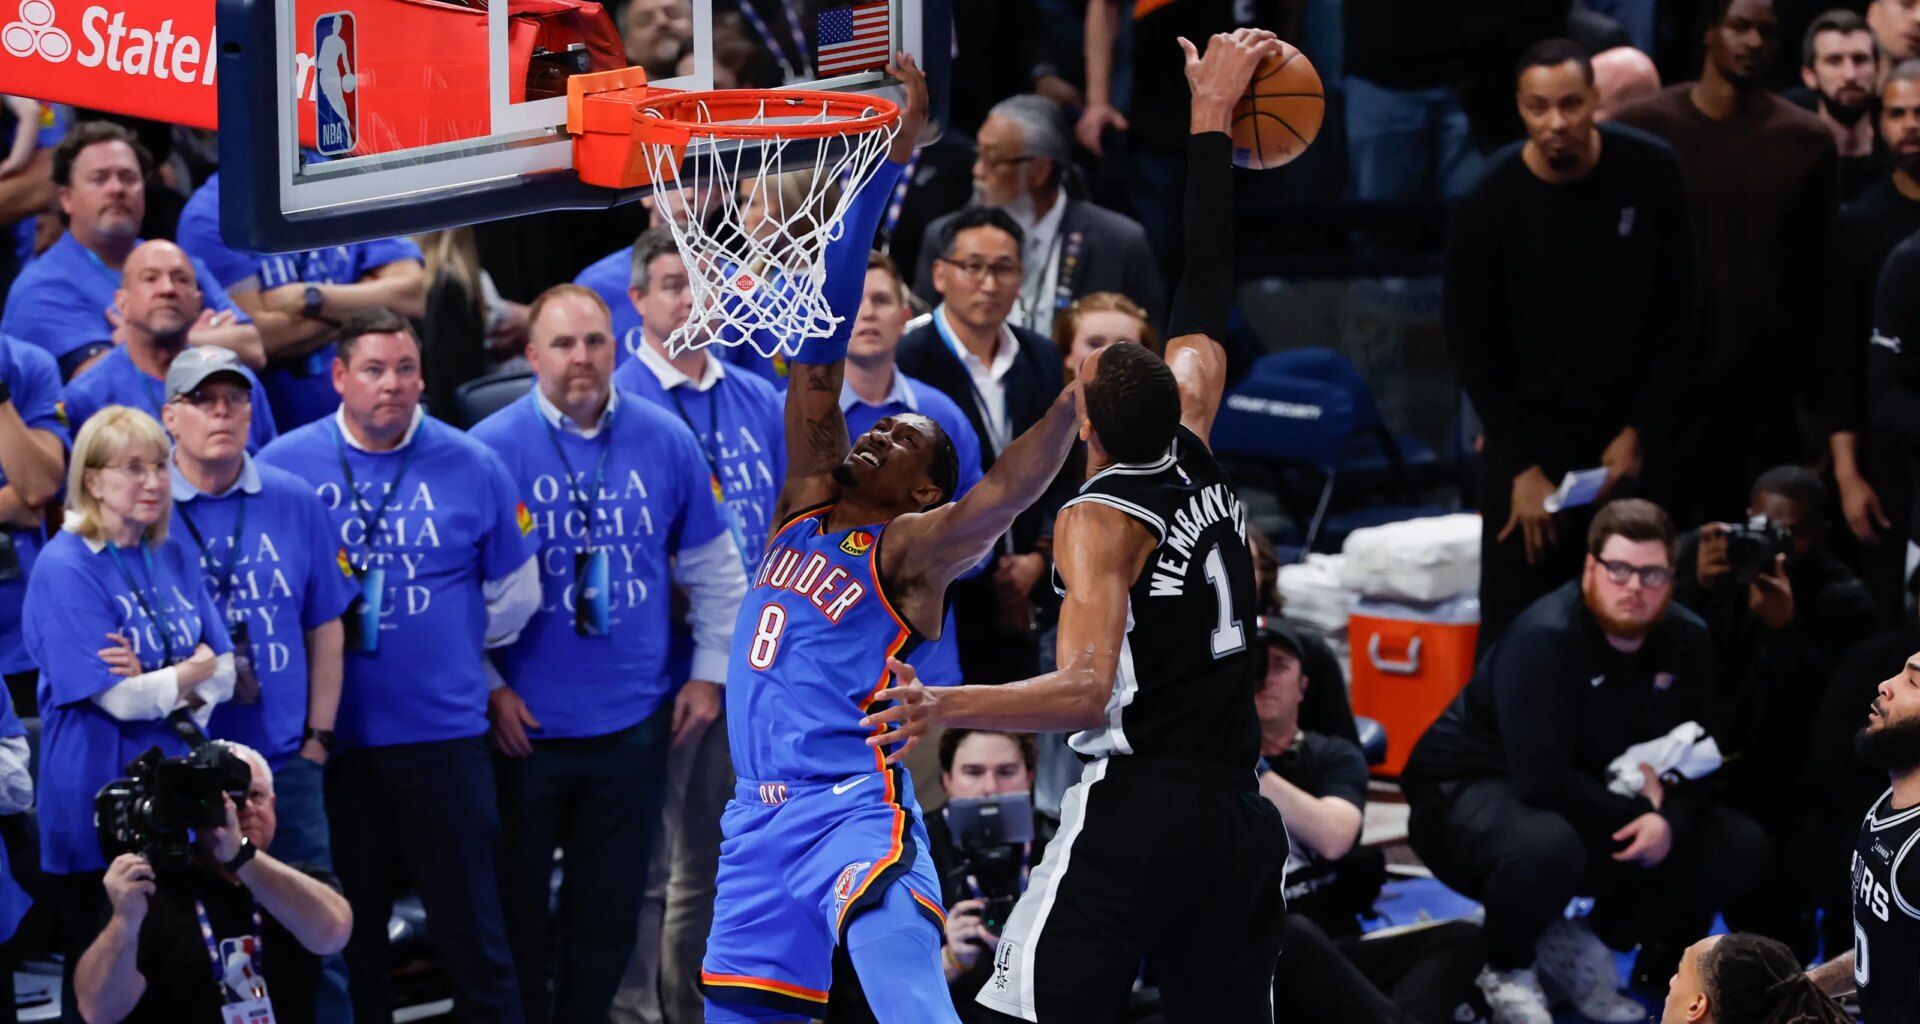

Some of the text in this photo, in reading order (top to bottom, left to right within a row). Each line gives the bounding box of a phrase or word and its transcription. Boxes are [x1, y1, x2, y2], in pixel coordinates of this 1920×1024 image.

[76, 5, 200, 83] State
[322, 122, 343, 146] NBA
[316, 481, 436, 512] OKLA
[532, 469, 648, 504] OKLA
[340, 516, 440, 548] OMA
[532, 505, 654, 540] HOMA
[544, 542, 643, 578] CTY
[752, 543, 866, 624] THUDER
[1203, 542, 1247, 660] 1
[749, 603, 787, 671] 8
[758, 784, 787, 804] OKC
